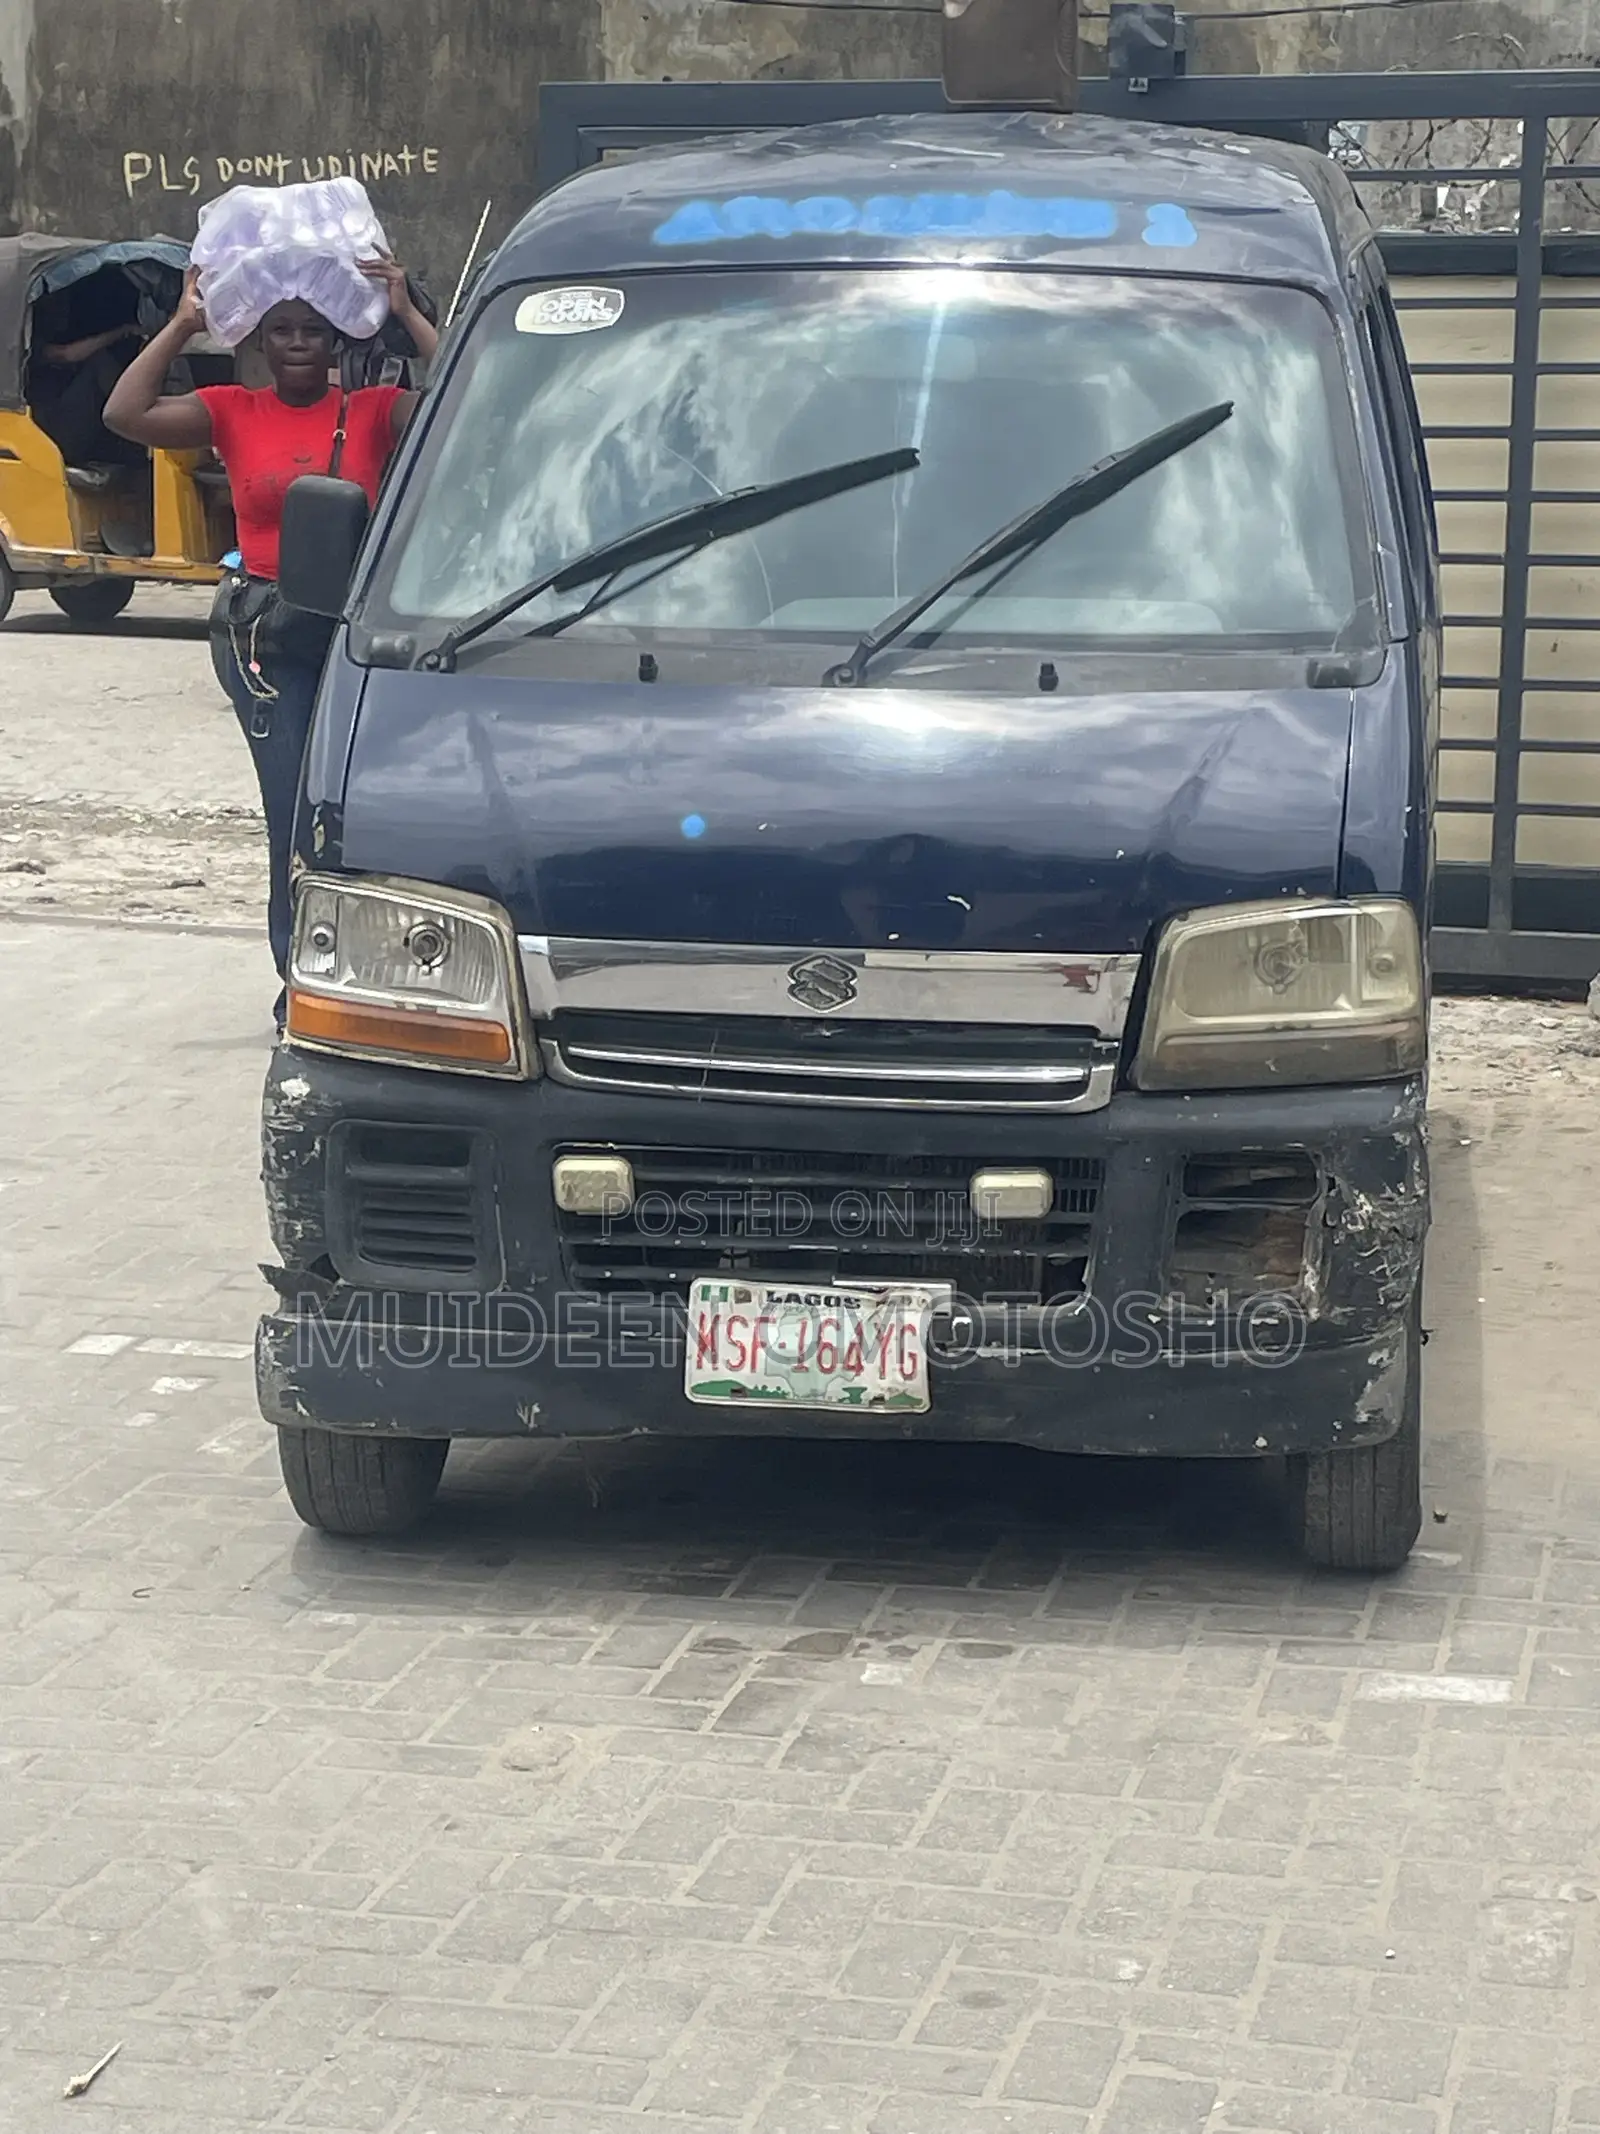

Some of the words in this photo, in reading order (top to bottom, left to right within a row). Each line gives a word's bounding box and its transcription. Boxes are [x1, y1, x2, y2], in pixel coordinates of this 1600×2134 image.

[123, 151, 201, 198] PLS
[541, 296, 607, 314] OPEN
[766, 1290, 861, 1310] LAGOS
